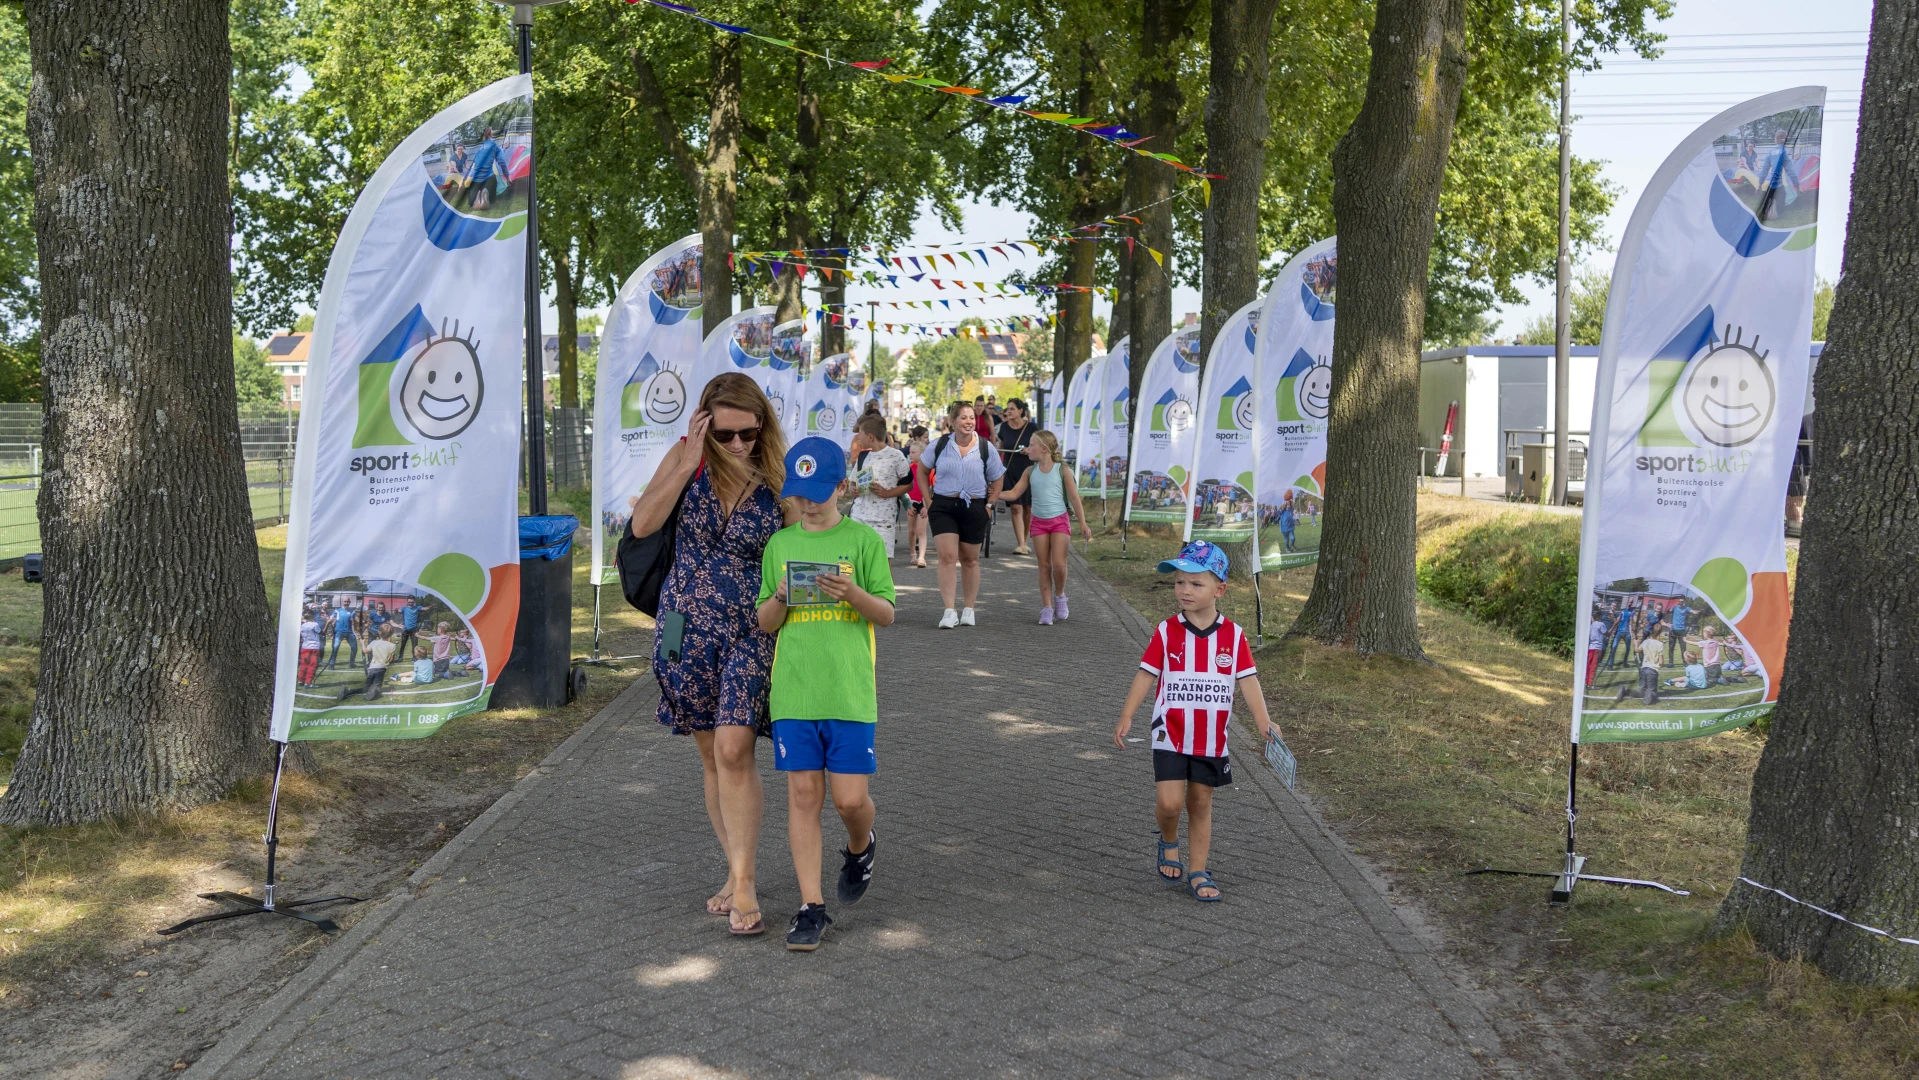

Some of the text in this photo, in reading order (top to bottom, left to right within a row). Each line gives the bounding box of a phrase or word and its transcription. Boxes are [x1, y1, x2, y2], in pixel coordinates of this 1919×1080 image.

[369, 473, 435, 484] Buitenschoolse
[1657, 476, 1724, 487] Buitenschoolse
[369, 485, 410, 496] Sportieve
[1657, 487, 1697, 497] Sportieve
[369, 496, 400, 506] Opvang
[1656, 498, 1687, 508] Opvang
[786, 609, 859, 624] INDHOVEN
[1167, 683, 1230, 694] BRAINPORT
[1166, 692, 1232, 704] EINDHOVEN
[300, 714, 400, 728] www.sportstuif.nl
[418, 714, 438, 724] 088
[1586, 719, 1683, 732] www.sportstuif.nl
[1699, 719, 1717, 728] 088
[1723, 713, 1741, 723] 633
[1742, 709, 1755, 718] 20
[1756, 707, 1770, 717] 20
